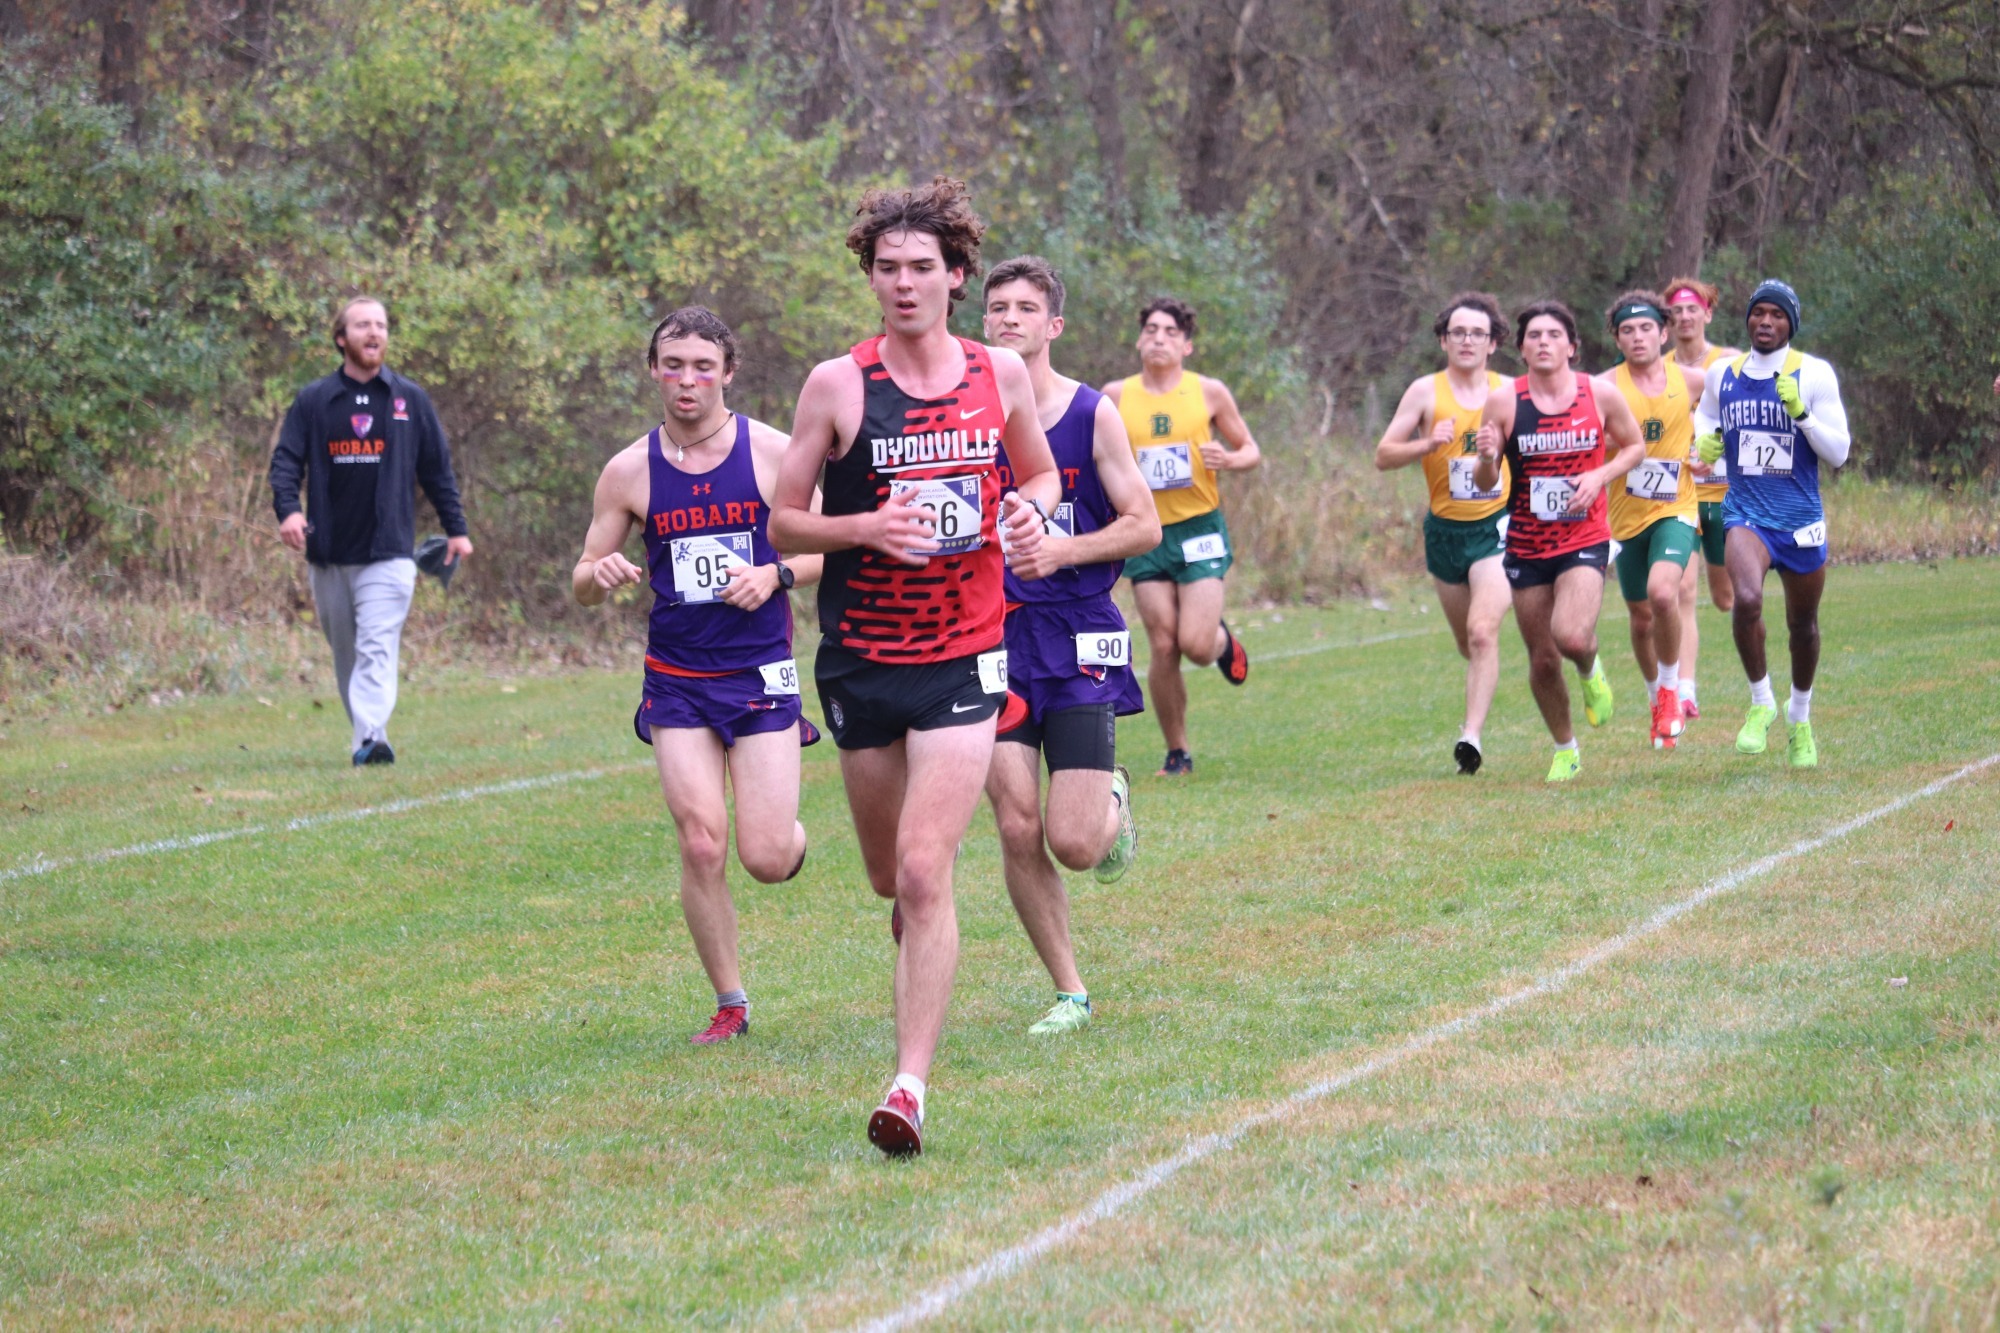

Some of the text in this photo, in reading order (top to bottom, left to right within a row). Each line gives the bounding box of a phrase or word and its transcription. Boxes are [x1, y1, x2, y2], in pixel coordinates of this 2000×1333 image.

[1154, 416, 1170, 436] B
[1646, 421, 1662, 441] B
[1755, 446, 1776, 468] 12
[1153, 459, 1176, 480] 48
[1643, 471, 1664, 491] 27
[1546, 491, 1571, 512] 65
[653, 502, 759, 536] HOBART
[1807, 527, 1823, 544] 12
[1198, 541, 1213, 554] 48
[695, 554, 731, 588] 95
[1096, 638, 1122, 659] 90
[780, 667, 796, 687] 95
[996, 659, 1008, 683] 6
